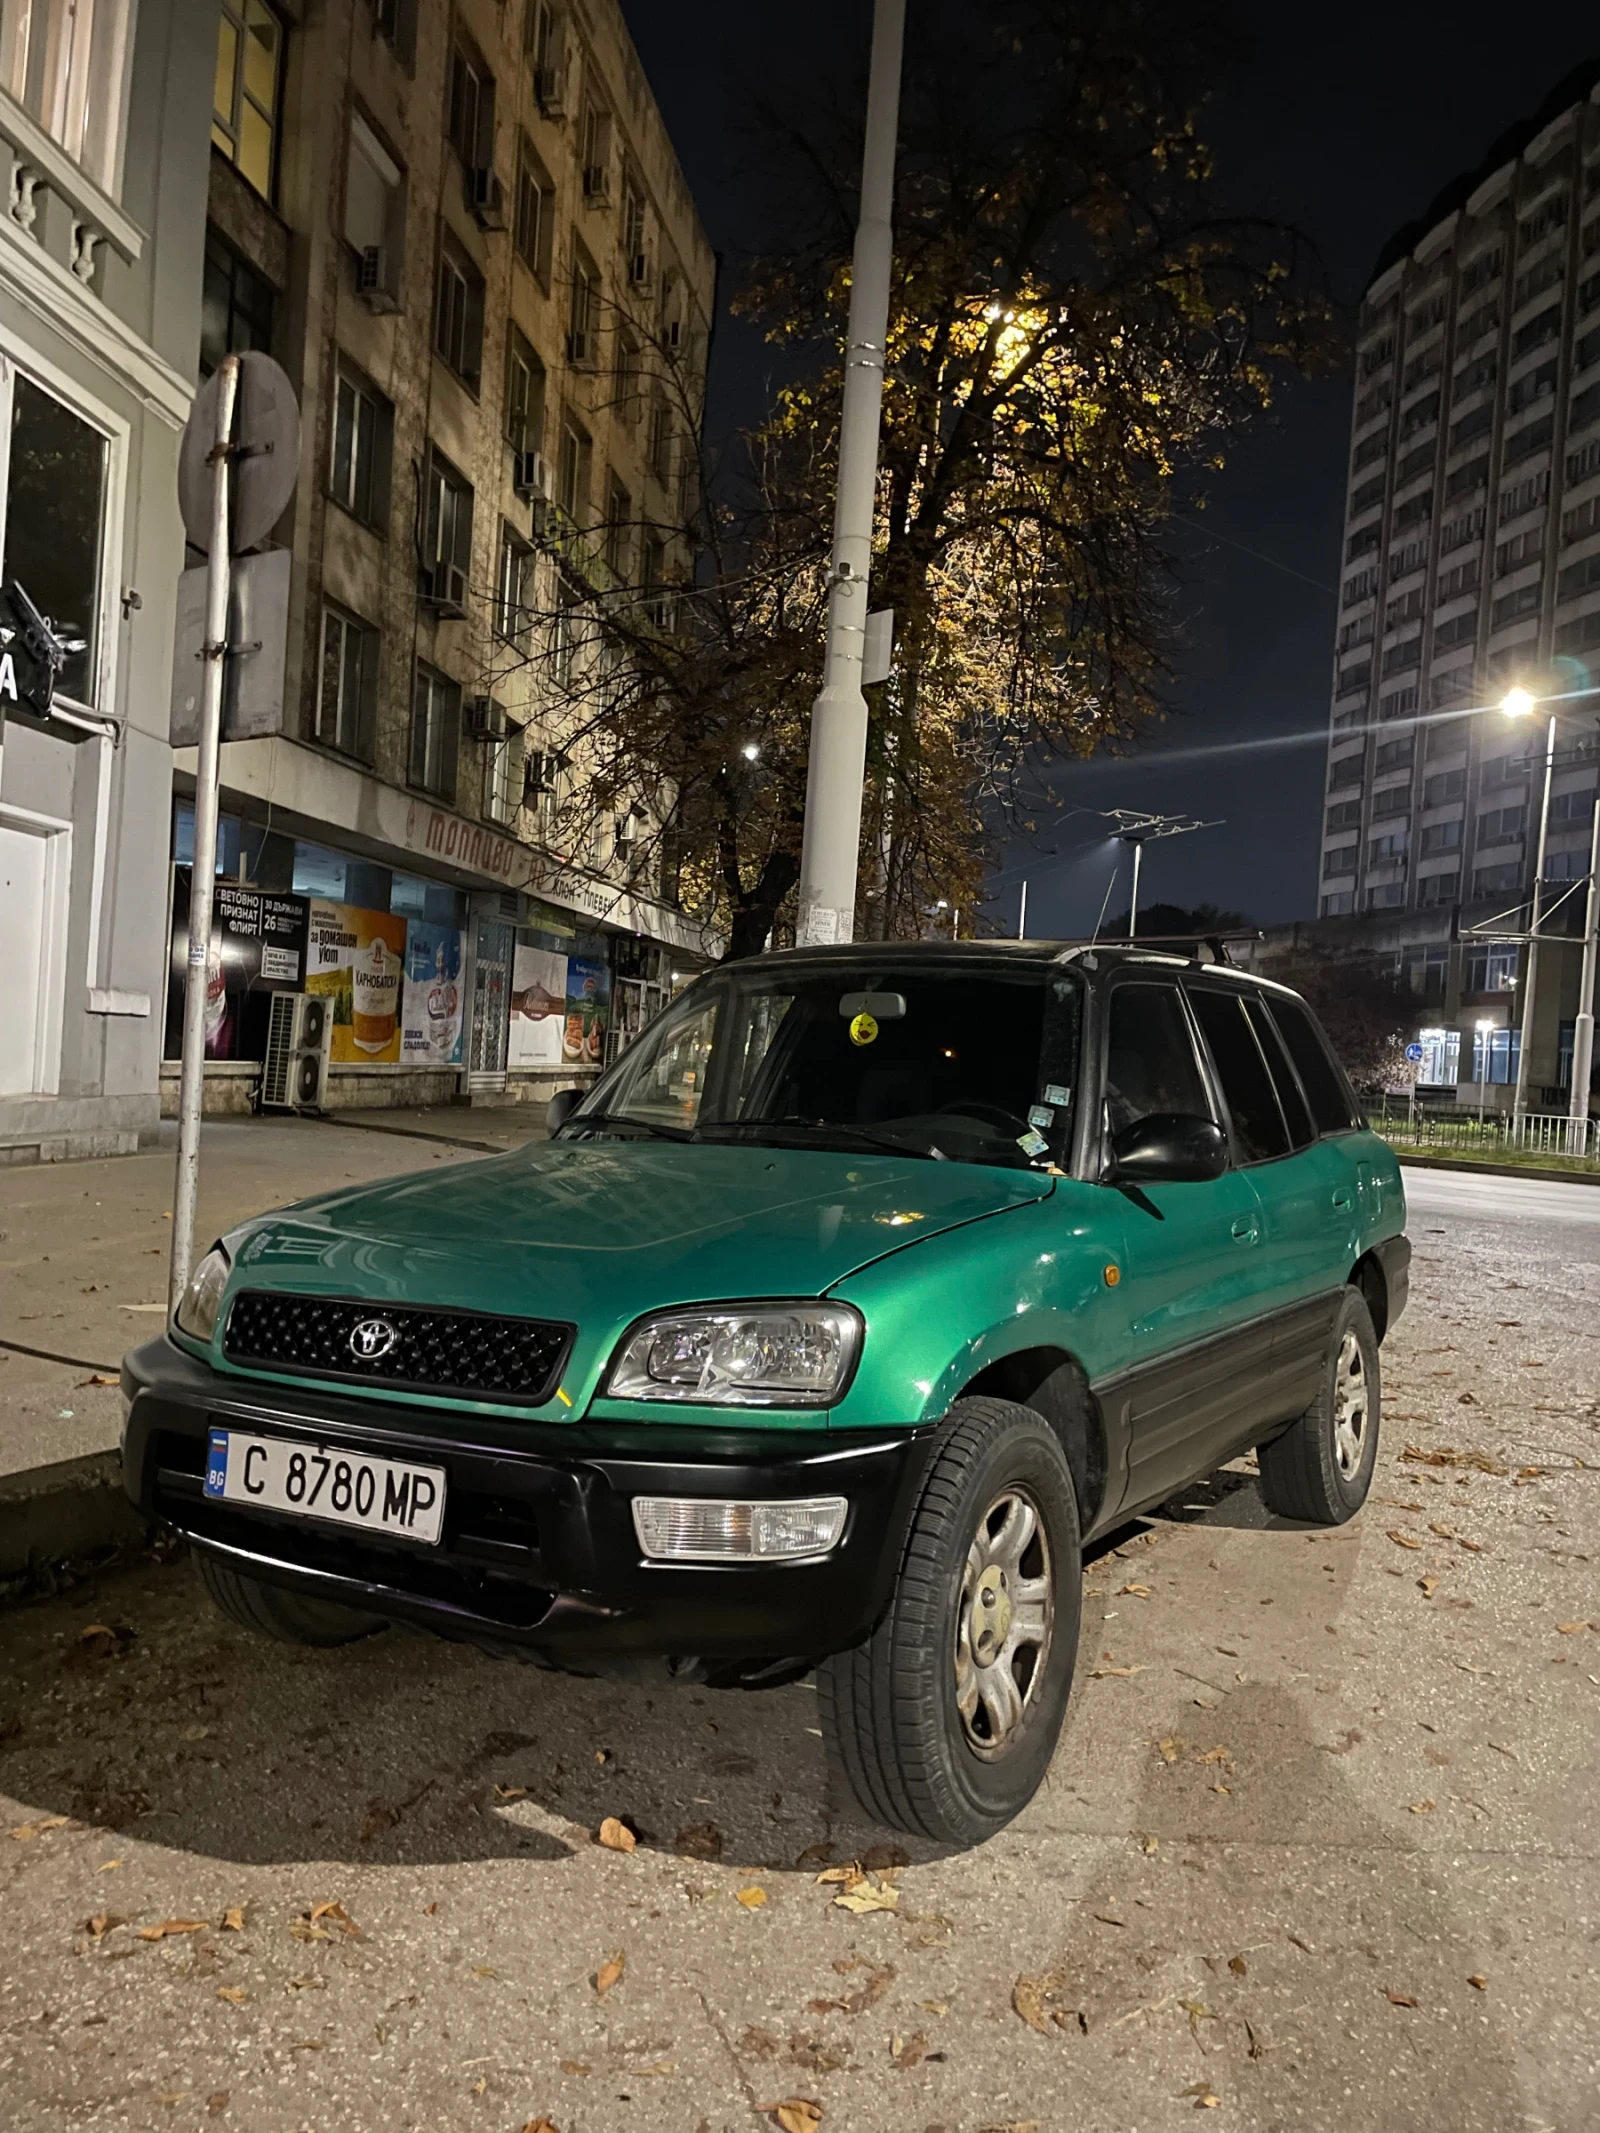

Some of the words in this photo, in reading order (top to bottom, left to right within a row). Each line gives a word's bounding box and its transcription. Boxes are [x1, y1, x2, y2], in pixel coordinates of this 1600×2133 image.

[215, 888, 260, 908] СВЕТОВНО
[220, 903, 259, 922] ПРИЗНАТ
[264, 914, 277, 931] 26
[229, 919, 258, 936] ФЛИРТ
[310, 931, 319, 943] за
[319, 929, 358, 949] домашен
[318, 945, 339, 965] уют
[208, 1470, 225, 1490] BG
[243, 1444, 268, 1495] C
[285, 1452, 376, 1517] 8780
[382, 1468, 437, 1528] MP
